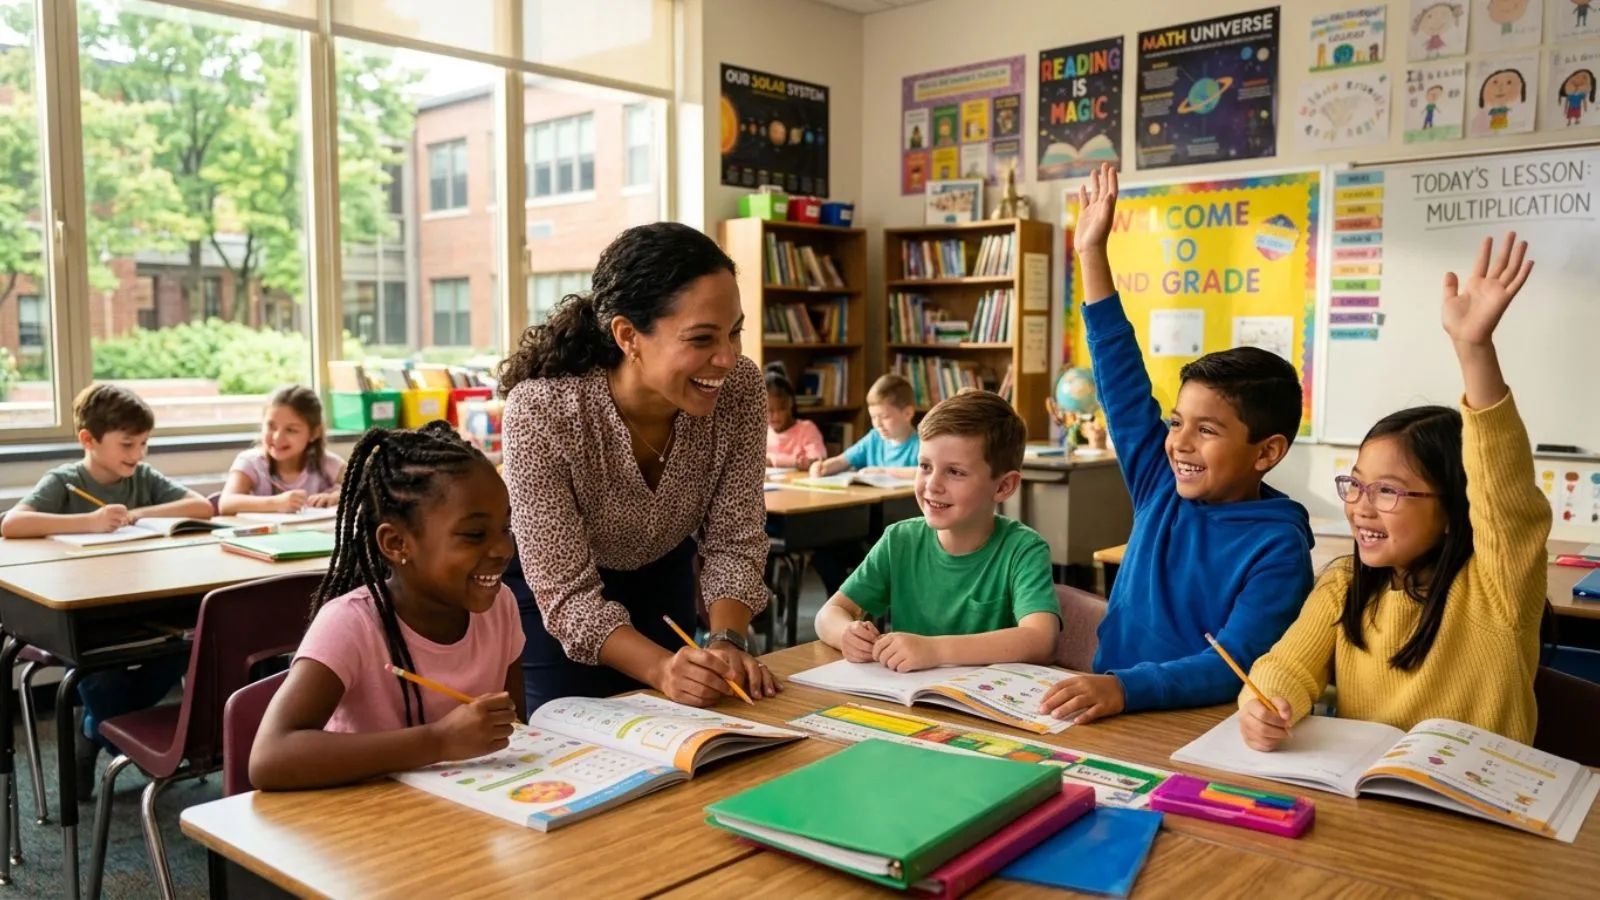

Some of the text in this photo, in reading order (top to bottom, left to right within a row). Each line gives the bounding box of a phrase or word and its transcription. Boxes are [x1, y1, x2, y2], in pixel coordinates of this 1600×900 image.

[1142, 30, 1187, 50] MATH
[1190, 13, 1274, 42] UNIVERSE
[1041, 47, 1121, 82] READING
[725, 69, 826, 102] OUR SOLAR SYSTEM
[1072, 78, 1087, 98] IS
[1050, 95, 1109, 125] MAGIC
[1412, 160, 1592, 194] TODAY'S LESSON:
[1112, 200, 1250, 233] WELCOME
[1426, 192, 1591, 223] MULTIPLICATION
[1160, 238, 1197, 264] TO
[1162, 268, 1260, 295] GRADE
